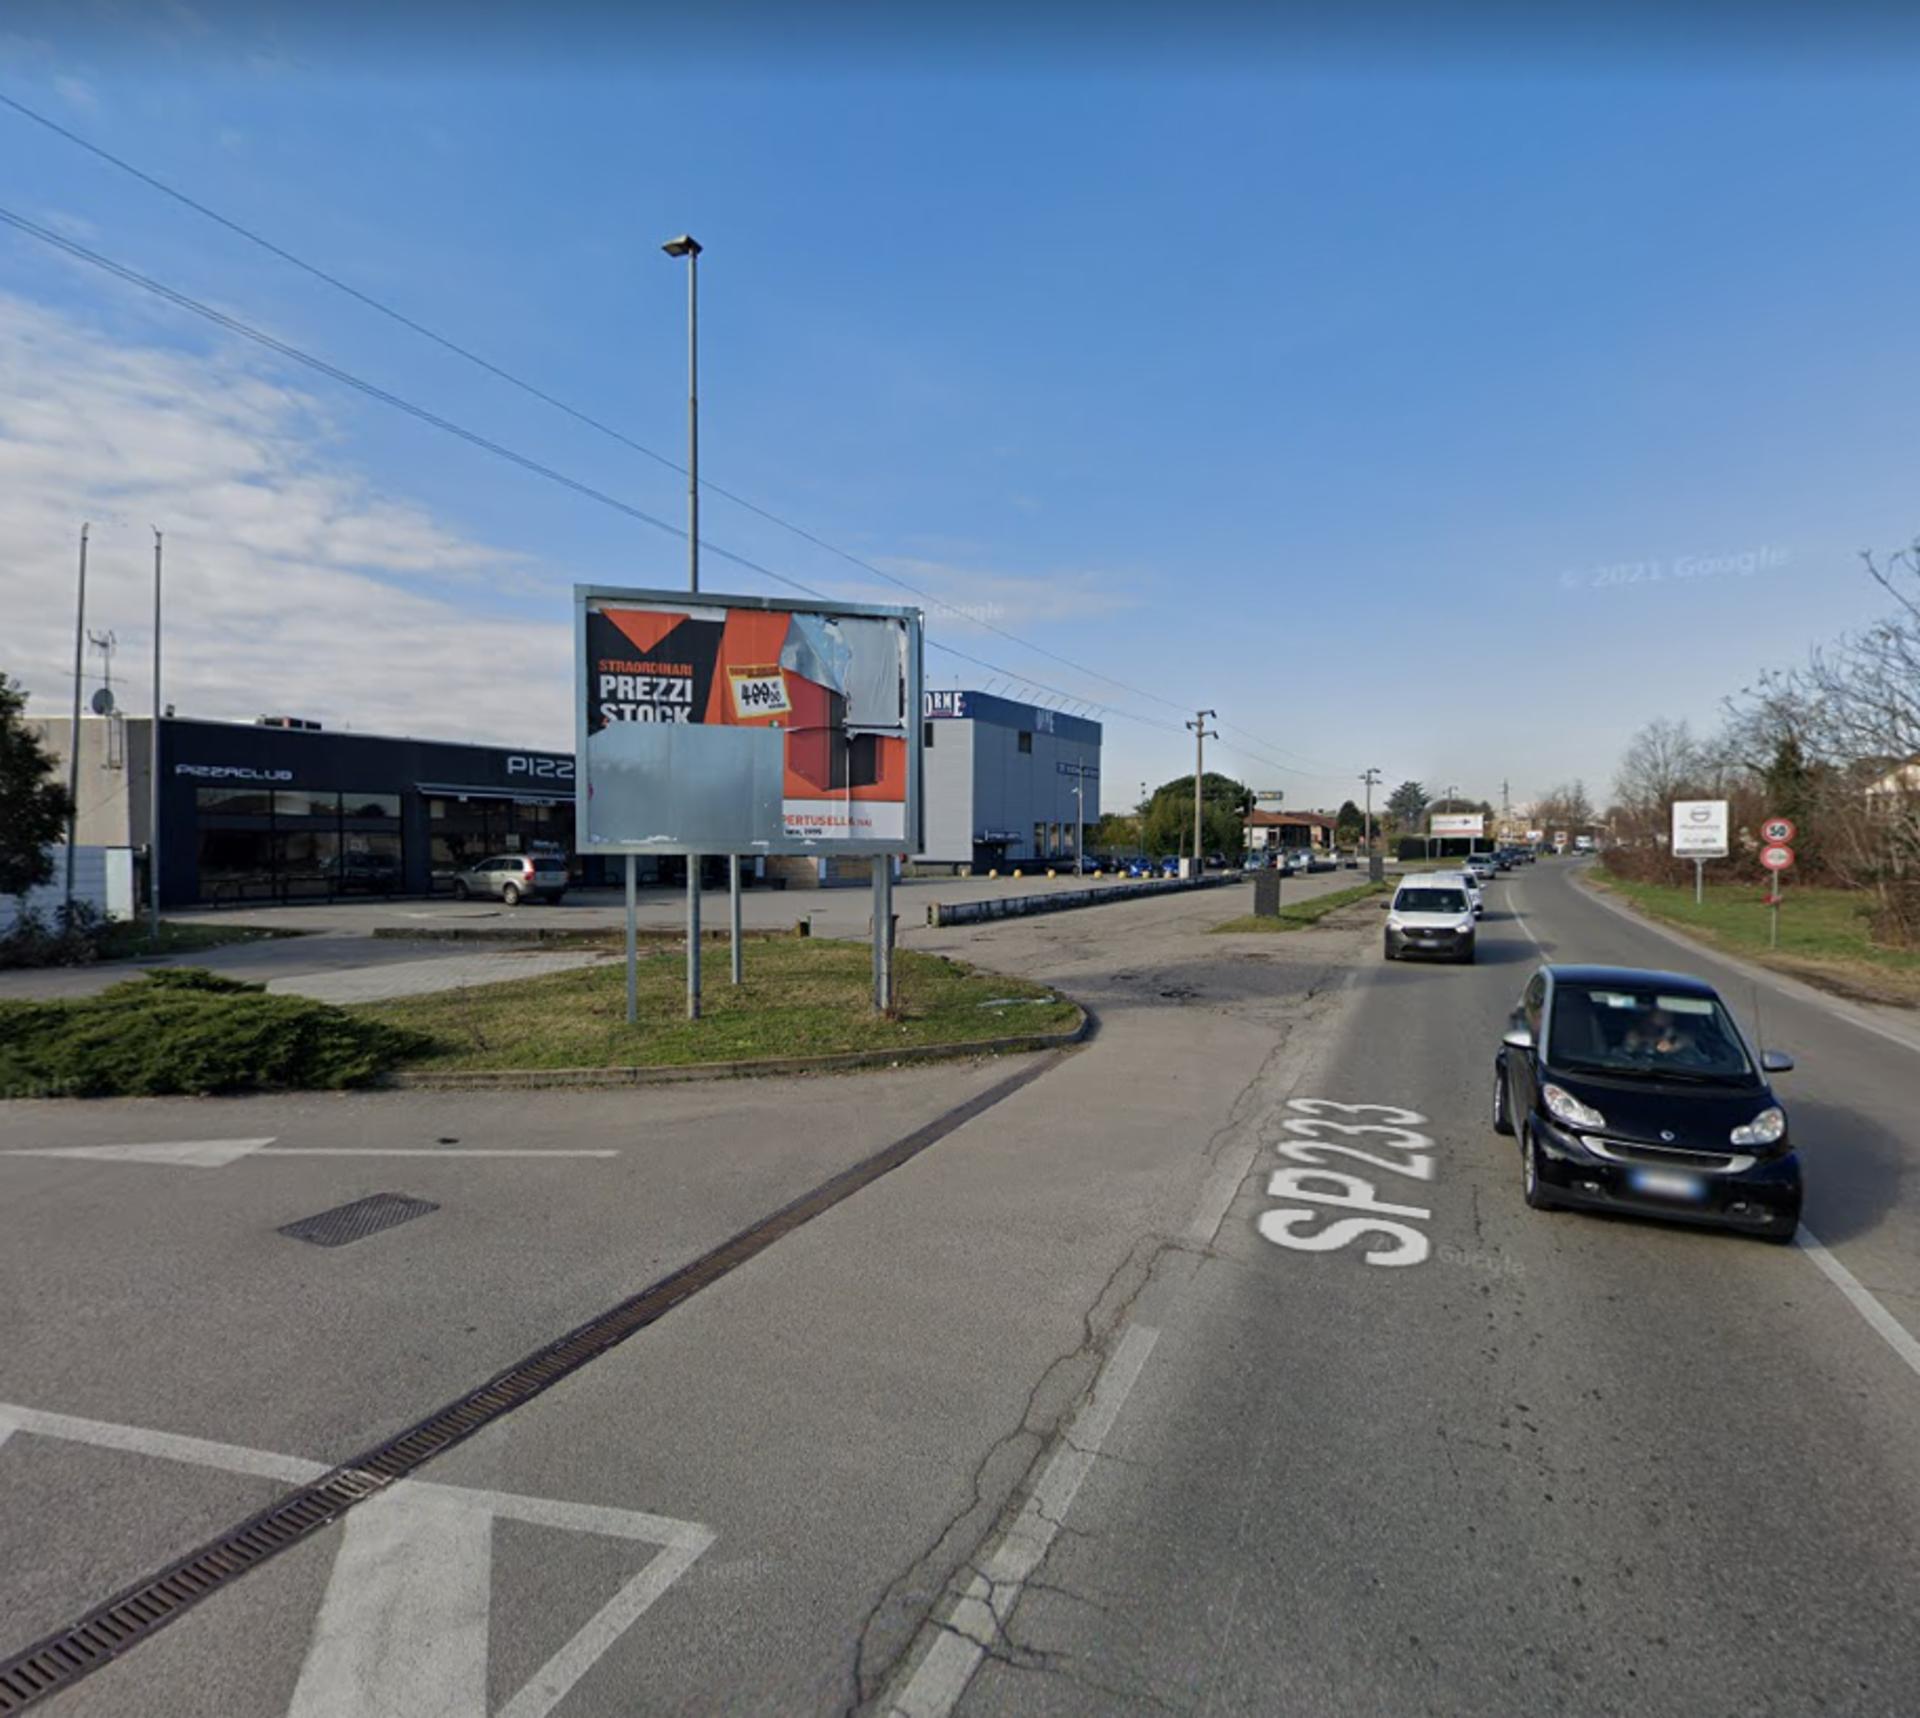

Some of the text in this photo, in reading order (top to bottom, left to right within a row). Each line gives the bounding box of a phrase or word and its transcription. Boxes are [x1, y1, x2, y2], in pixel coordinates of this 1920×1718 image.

[599, 660, 692, 676] STRAORDINARI
[600, 674, 693, 702] PREZZI
[600, 702, 693, 725] STOCK
[1769, 824, 1788, 837] 50
[1258, 1098, 1435, 1266] SP233
